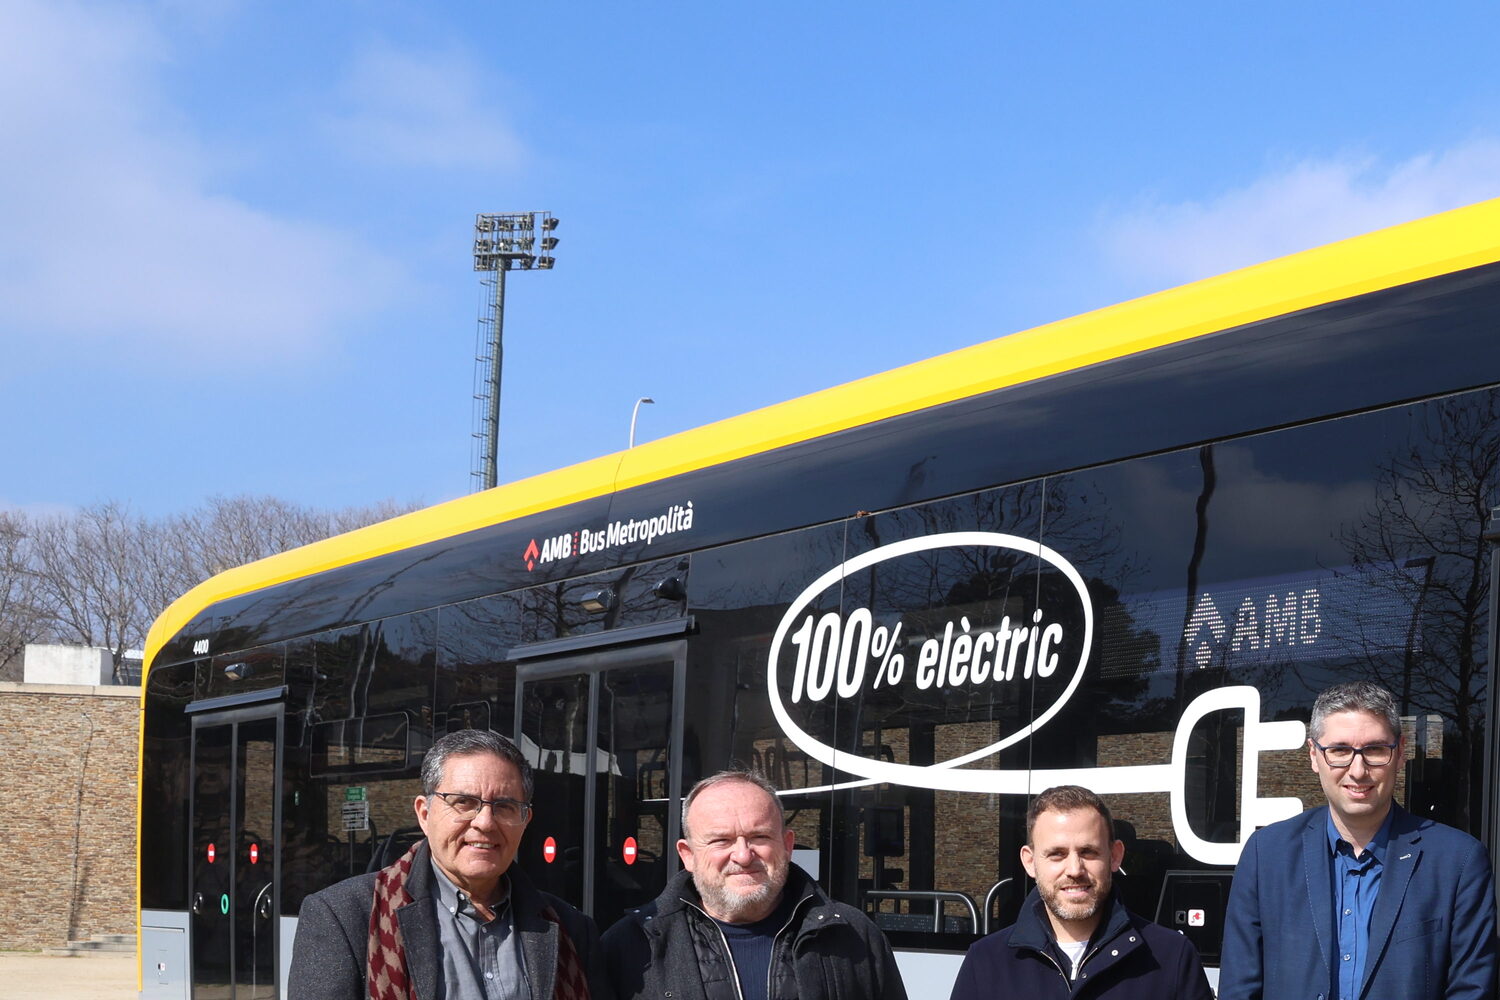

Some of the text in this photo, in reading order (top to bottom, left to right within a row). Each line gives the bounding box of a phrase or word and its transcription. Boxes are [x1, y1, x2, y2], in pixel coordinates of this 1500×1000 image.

[540, 500, 694, 564] AMB Bus Metropolità
[193, 639, 209, 655] 4400
[1232, 588, 1321, 651] AMB
[791, 607, 1063, 704] 100% elèctric
